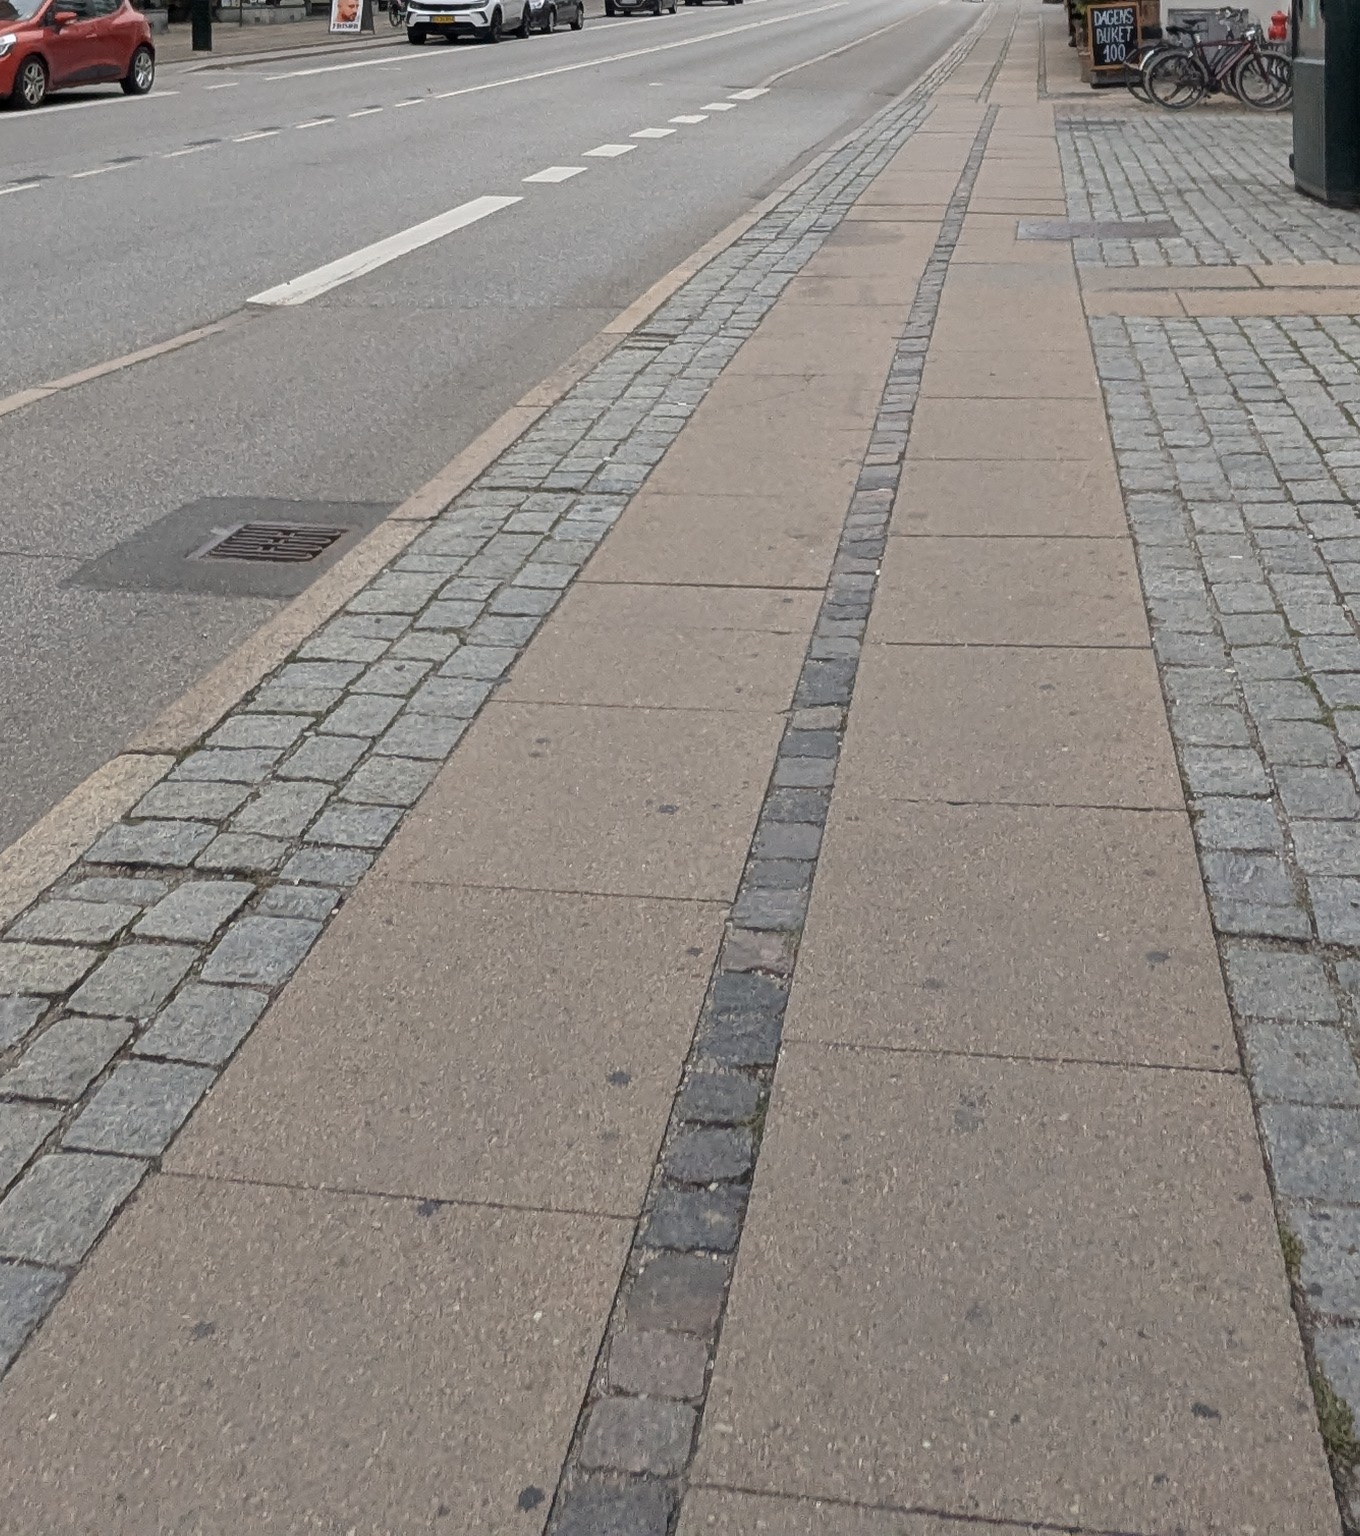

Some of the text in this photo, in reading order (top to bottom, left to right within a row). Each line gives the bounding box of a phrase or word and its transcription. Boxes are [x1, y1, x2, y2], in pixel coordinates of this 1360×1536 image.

[1093, 8, 1134, 26] DAGENS
[1096, 26, 1134, 45] BUKET
[1103, 44, 1126, 63] 100
